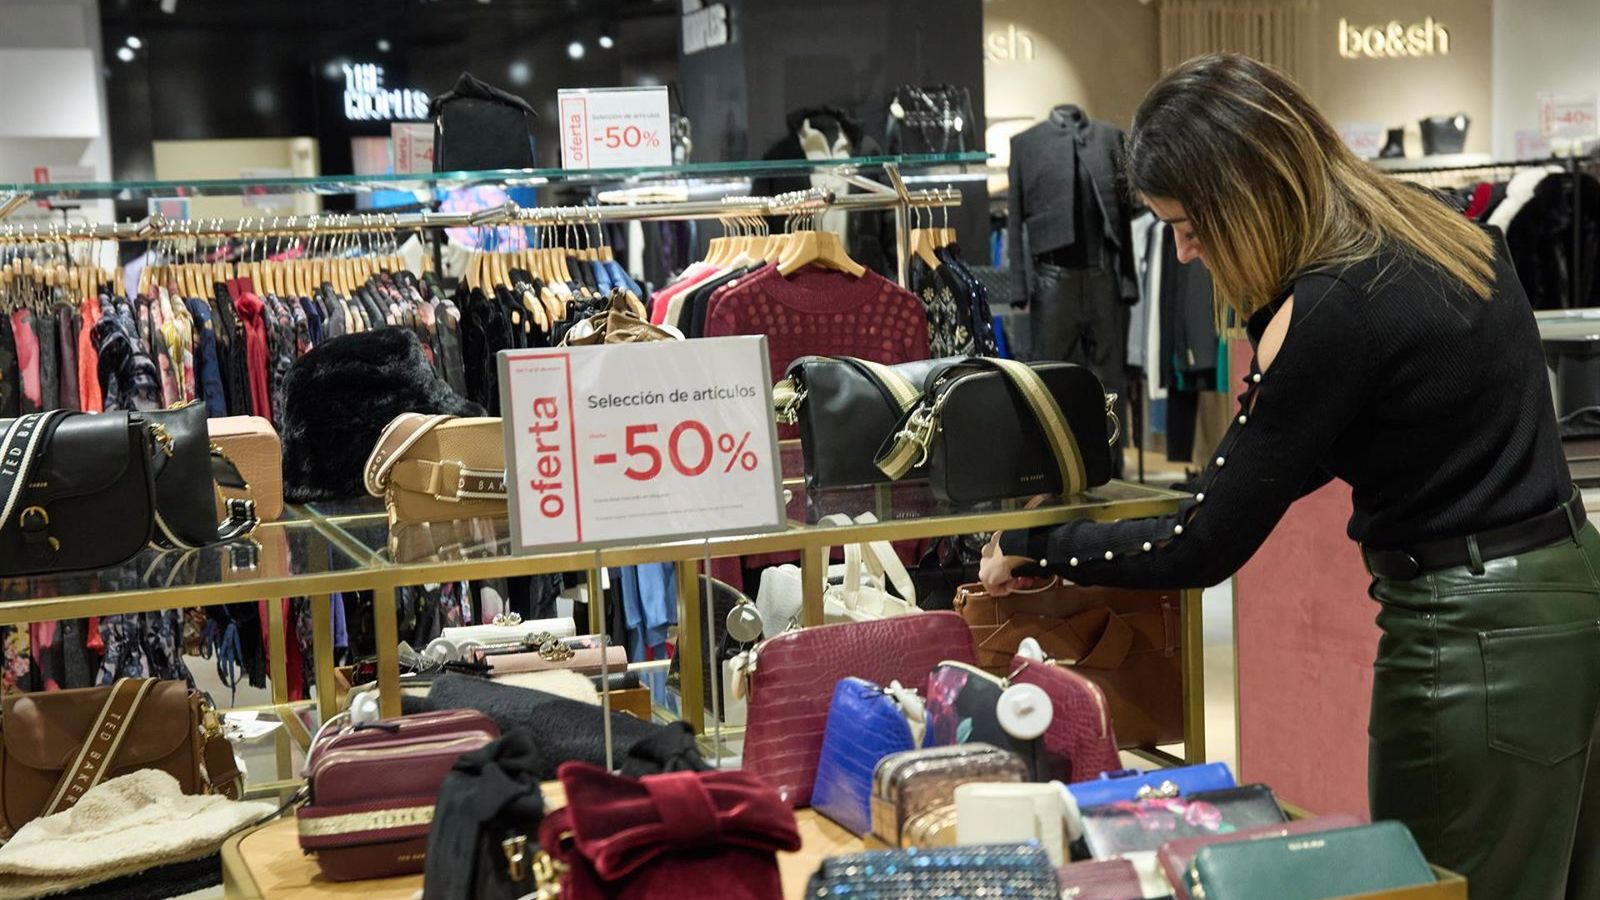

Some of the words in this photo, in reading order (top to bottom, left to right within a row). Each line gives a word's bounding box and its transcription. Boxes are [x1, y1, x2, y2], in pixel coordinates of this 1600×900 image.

[570, 114, 583, 161] oferta
[594, 126, 660, 148] -50%
[588, 390, 664, 409] Selección
[669, 389, 688, 404] de
[693, 384, 756, 401] artículos
[1, 447, 22, 475] TED
[528, 396, 564, 518] oferta
[594, 420, 758, 481] -50%
[478, 480, 505, 491] BAK
[100, 713, 122, 741] TED
